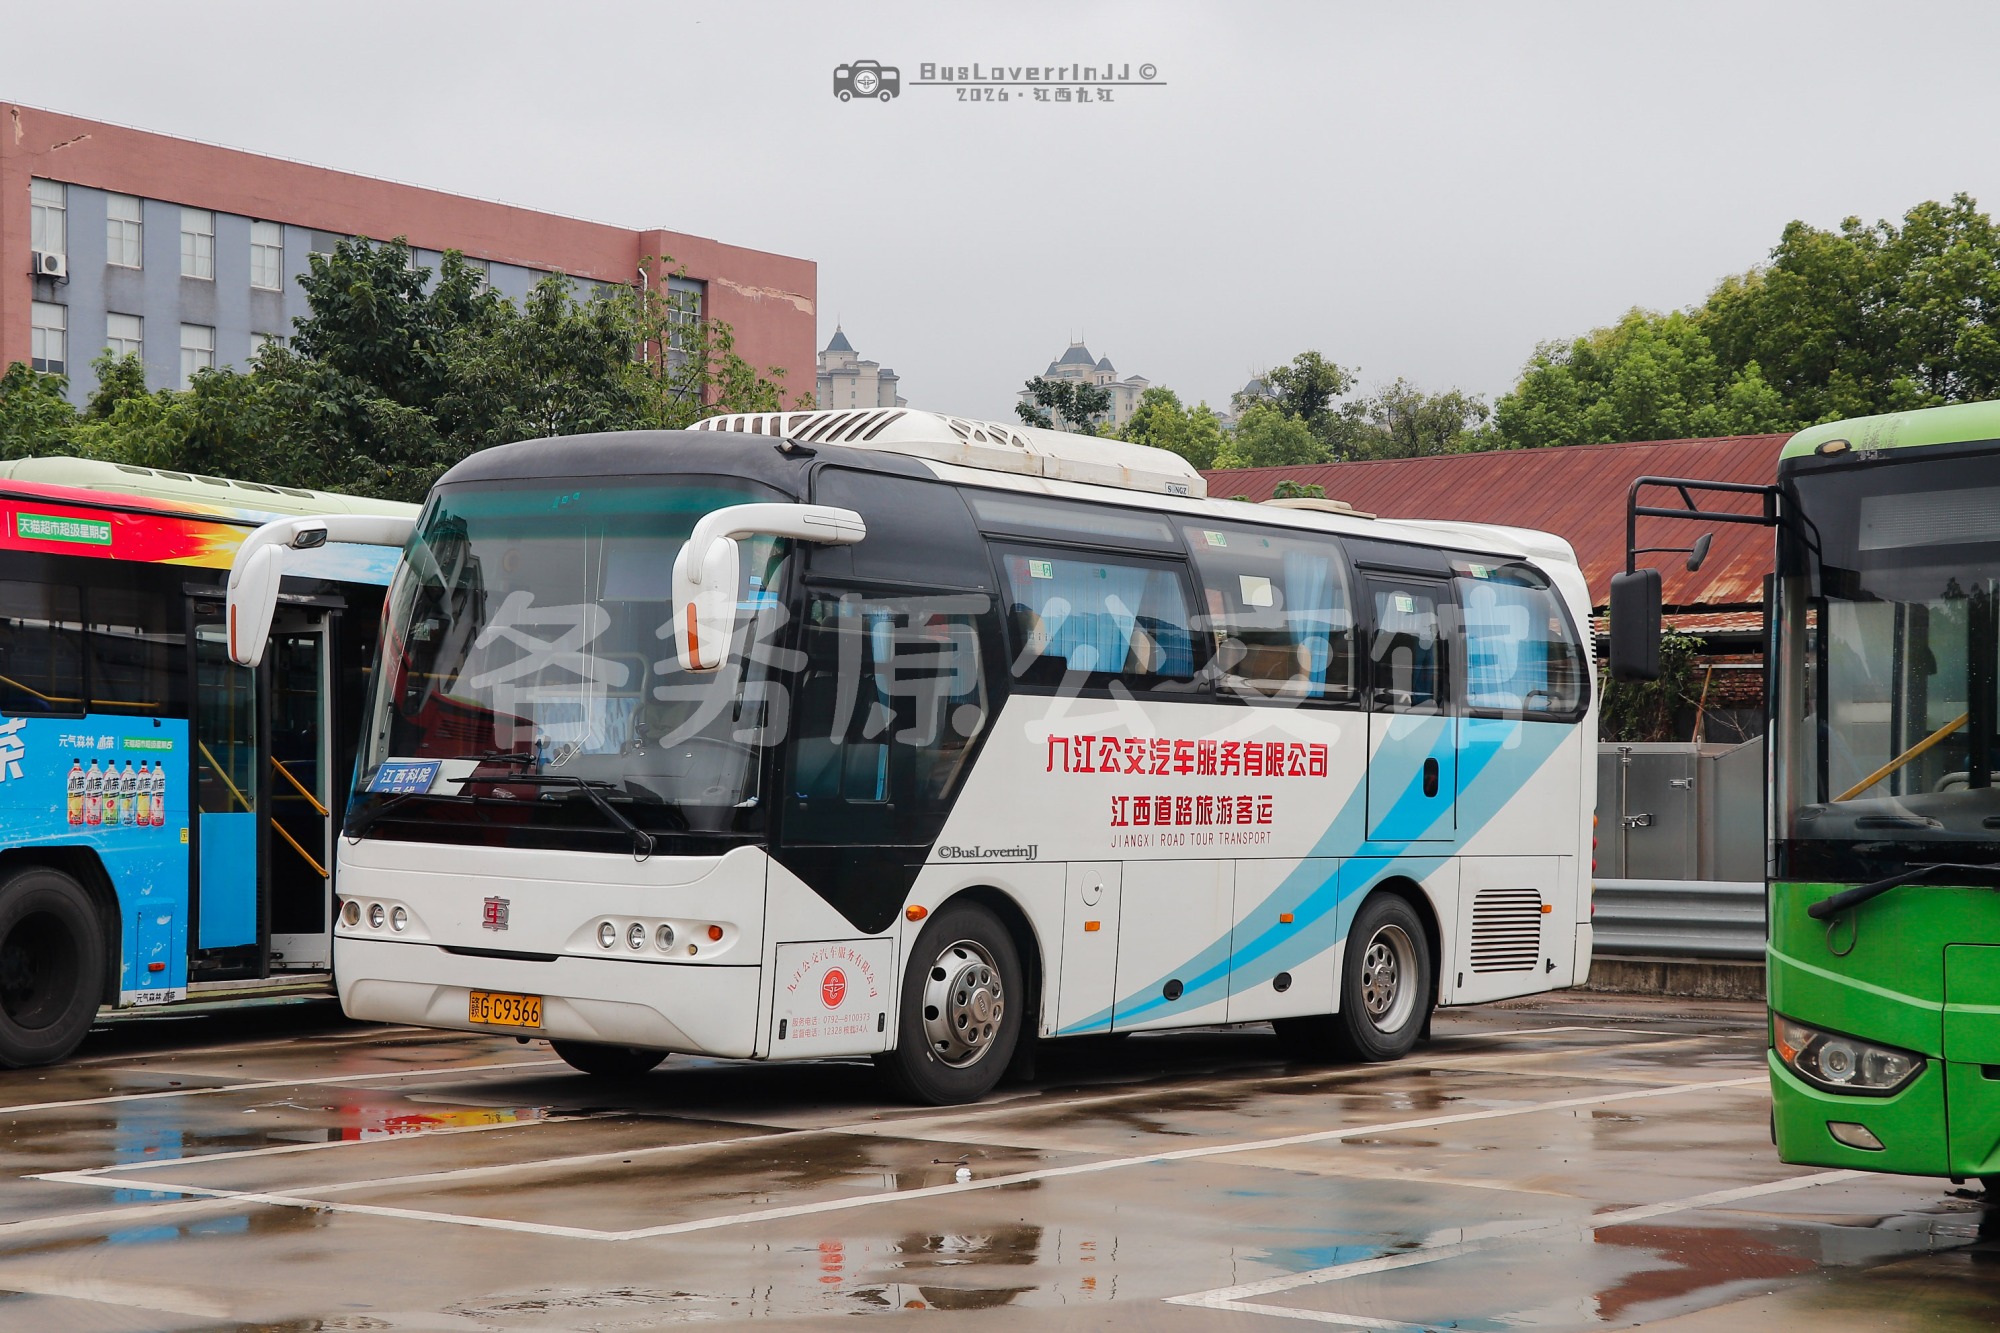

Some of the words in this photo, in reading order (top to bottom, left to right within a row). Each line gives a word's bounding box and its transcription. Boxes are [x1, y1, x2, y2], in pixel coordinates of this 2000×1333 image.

[19, 518, 110, 540] 天猫超市超级星期5
[58, 734, 95, 749] 元气森林
[1046, 733, 1328, 778] 九江公交汽车服务有限公司
[380, 766, 432, 785] 江西科院
[1110, 794, 1273, 827] 江西道路旅游客运
[1111, 833, 1155, 848] JIANGXI
[1160, 832, 1186, 847] ROAD
[1190, 832, 1214, 846] TOUR
[1219, 830, 1272, 846] TRANSPORT
